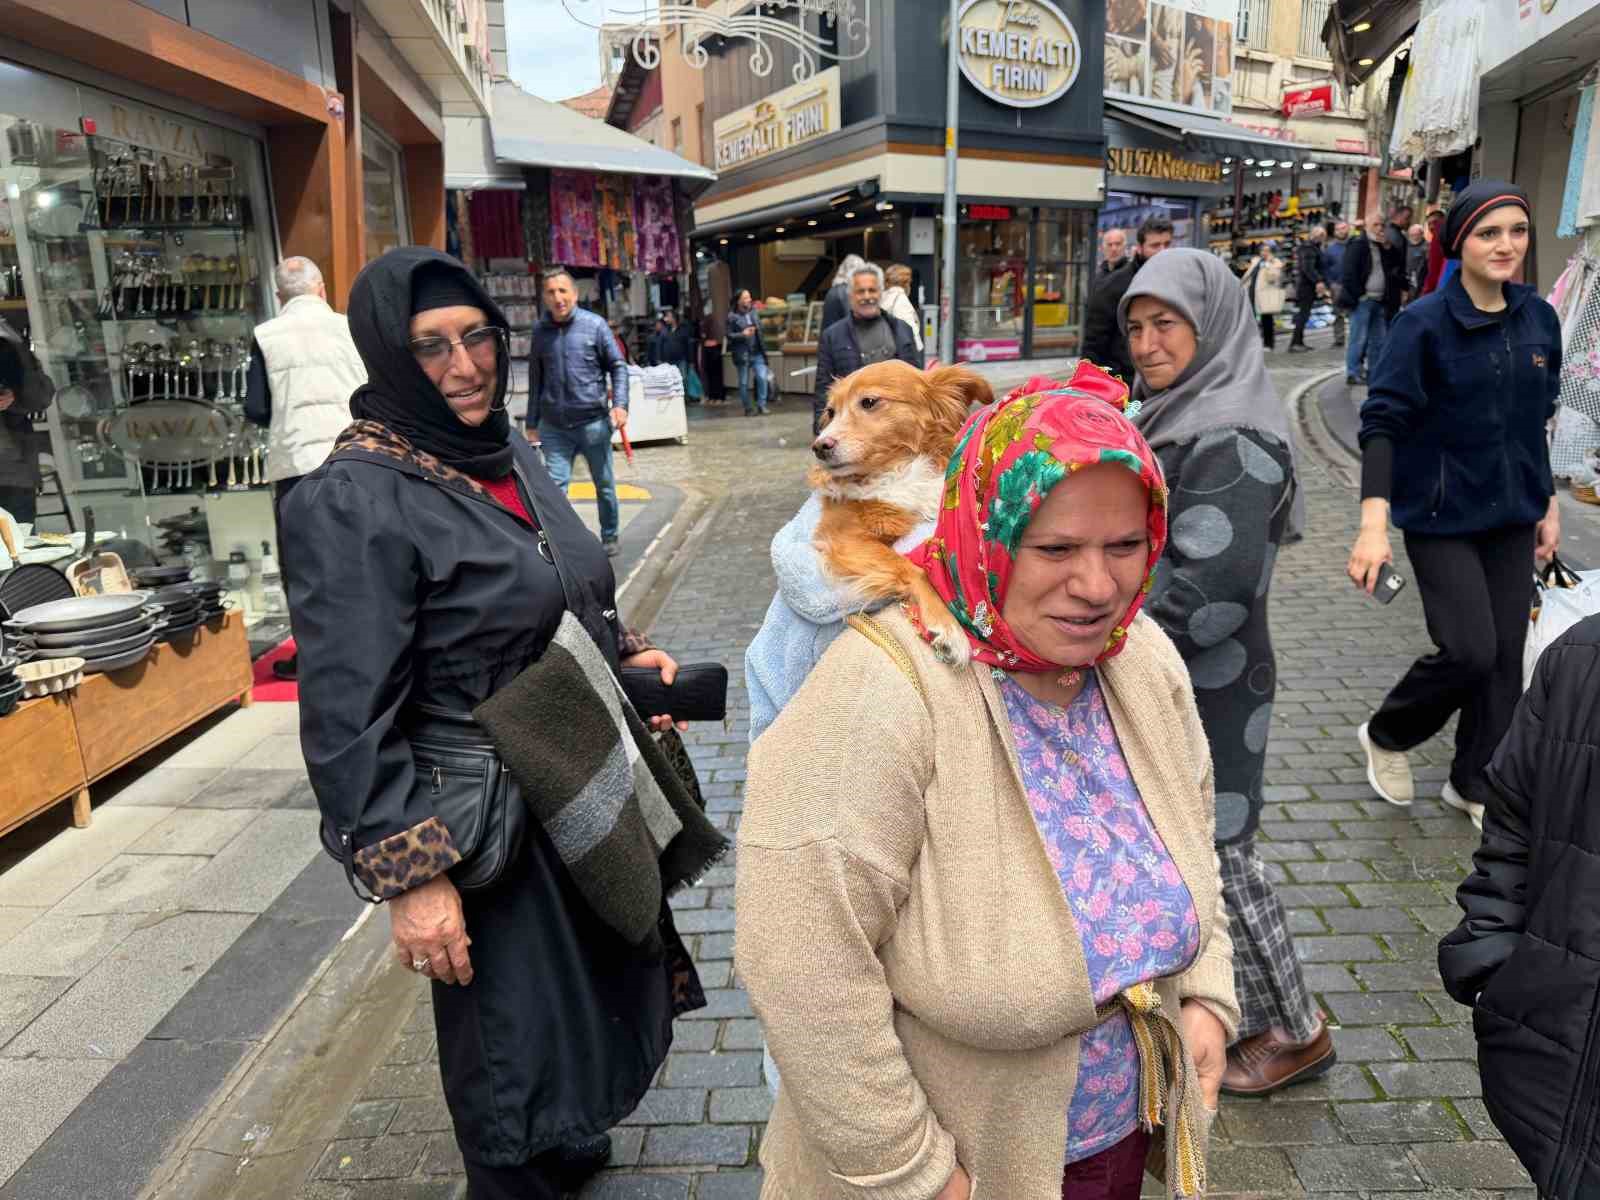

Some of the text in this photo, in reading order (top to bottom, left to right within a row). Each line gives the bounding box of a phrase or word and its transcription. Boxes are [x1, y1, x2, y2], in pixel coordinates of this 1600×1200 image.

[961, 28, 1073, 67] KEMERALTI
[992, 64, 1049, 92] FIRINI
[716, 122, 778, 167] KEMERALTI
[784, 102, 824, 147] FIRINI
